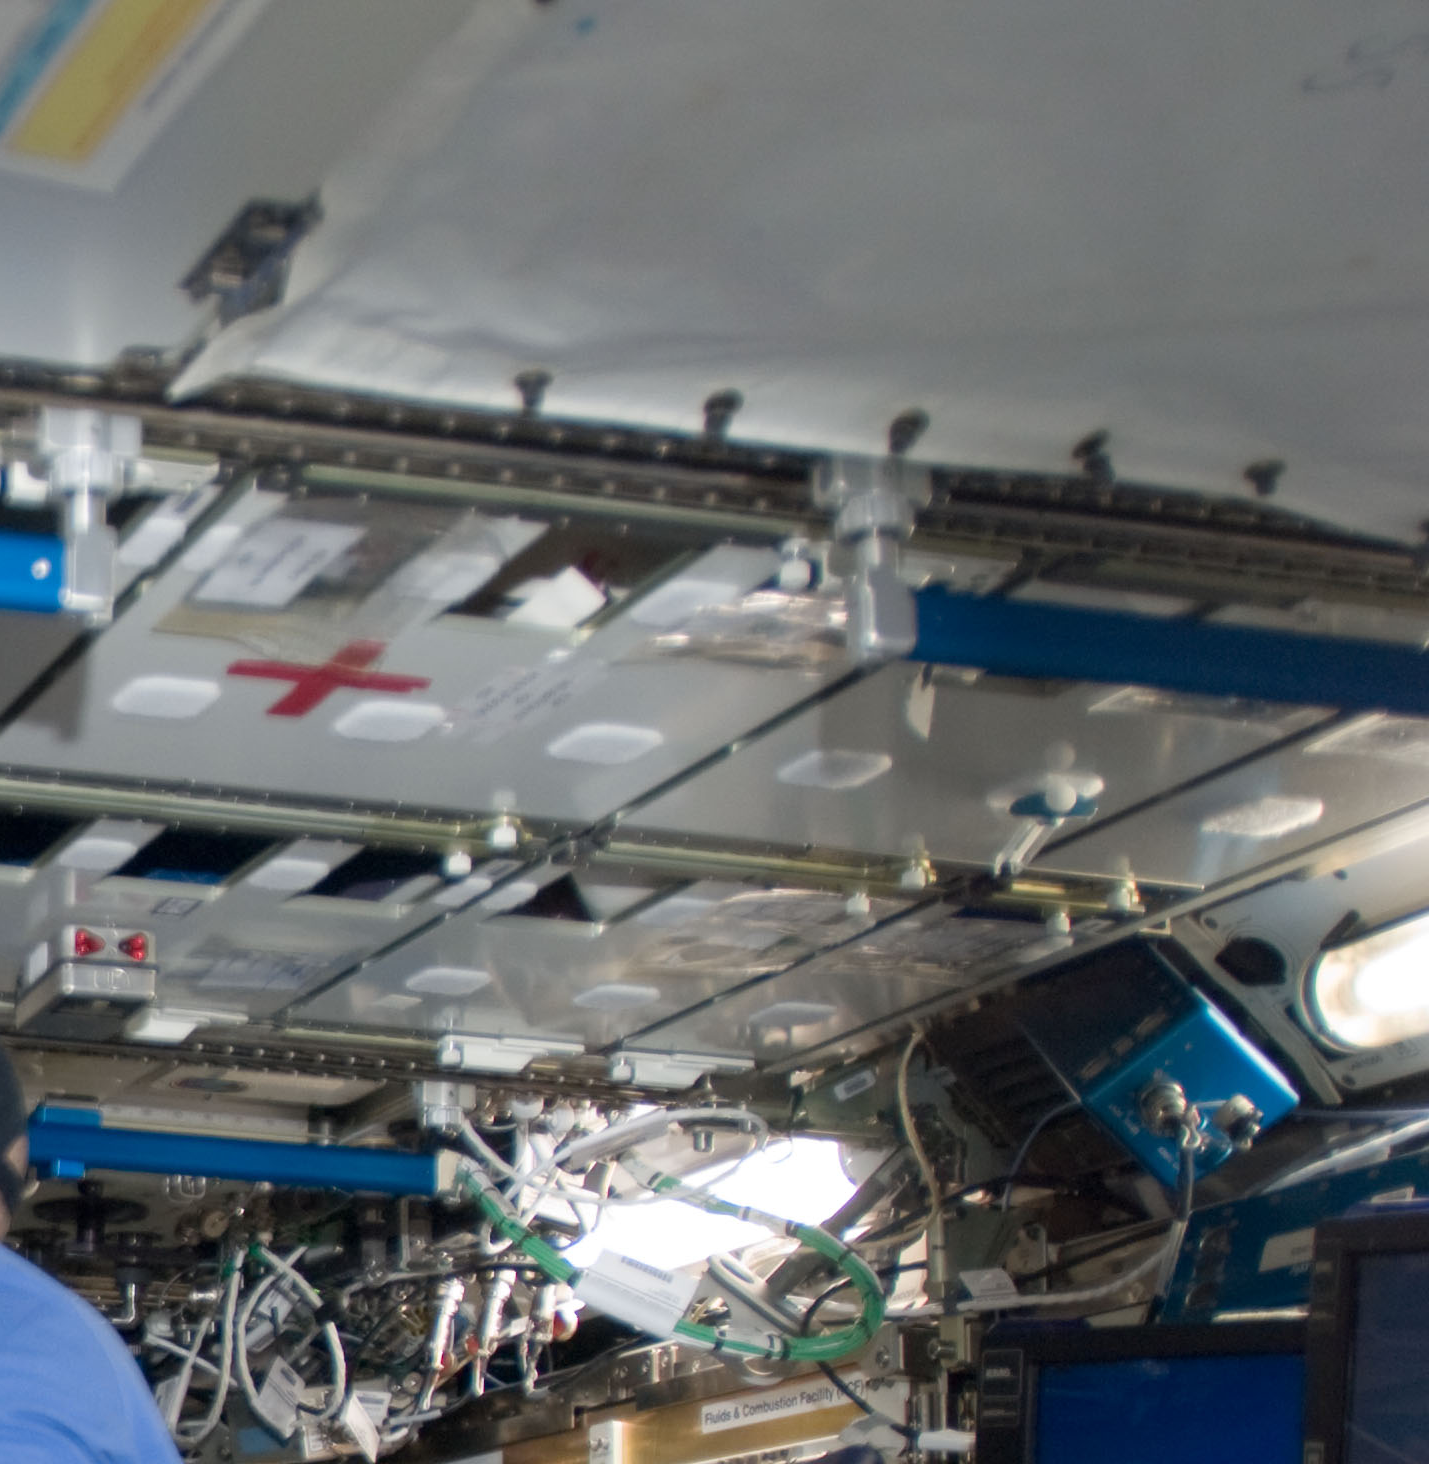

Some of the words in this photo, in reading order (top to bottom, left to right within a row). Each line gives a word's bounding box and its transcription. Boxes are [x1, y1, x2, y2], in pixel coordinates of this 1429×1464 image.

[704, 1409, 731, 1425] Fluids
[733, 1407, 741, 1419] &
[742, 1395, 798, 1414] Combustion
[800, 1388, 834, 1405] Facility
